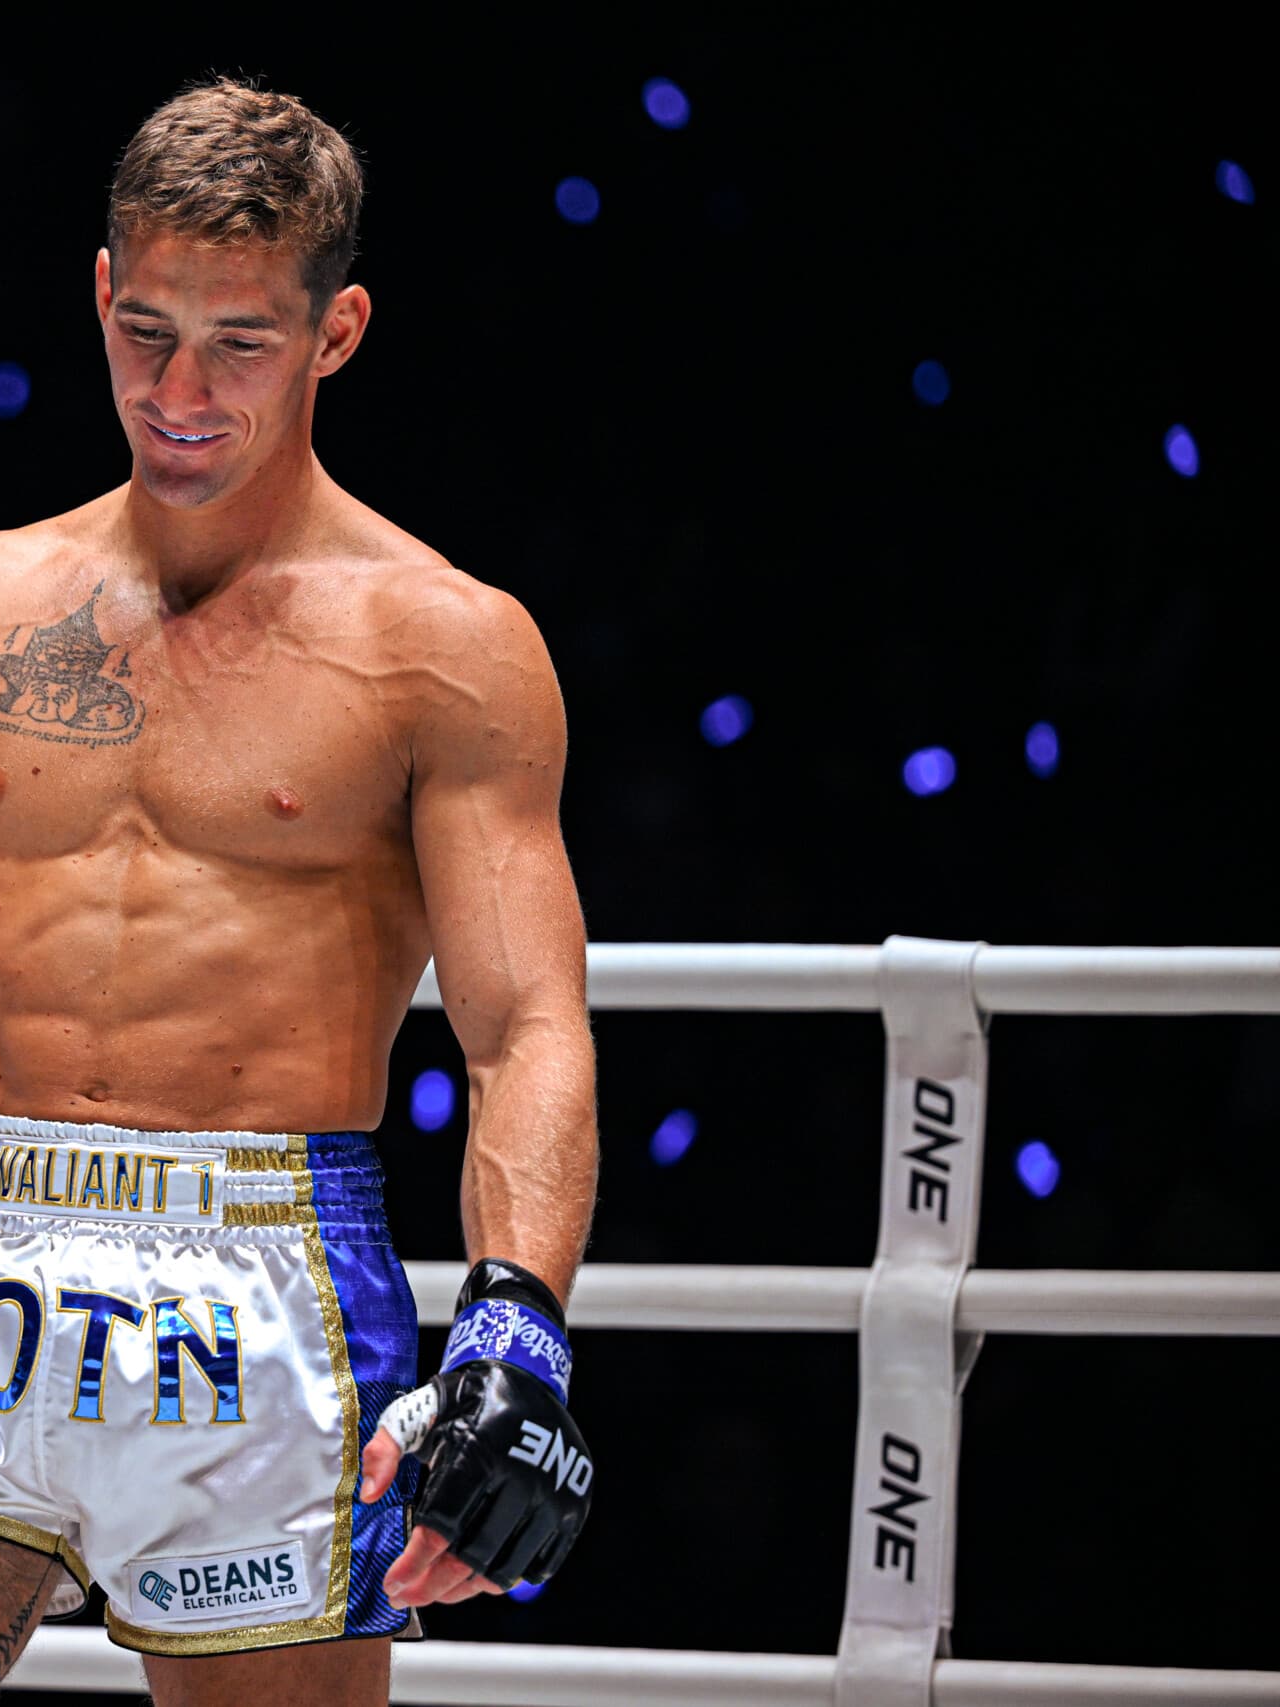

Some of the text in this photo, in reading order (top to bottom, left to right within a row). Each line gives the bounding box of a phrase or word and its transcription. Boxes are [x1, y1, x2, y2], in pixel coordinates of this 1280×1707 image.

[902, 1077, 964, 1225] ONE
[192, 1160, 215, 1215] 1
[508, 1418, 593, 1497] ONE
[867, 1432, 932, 1583] ONE
[179, 1553, 294, 1597] DEANS
[184, 1583, 297, 1610] ELECTRICAL LTD
